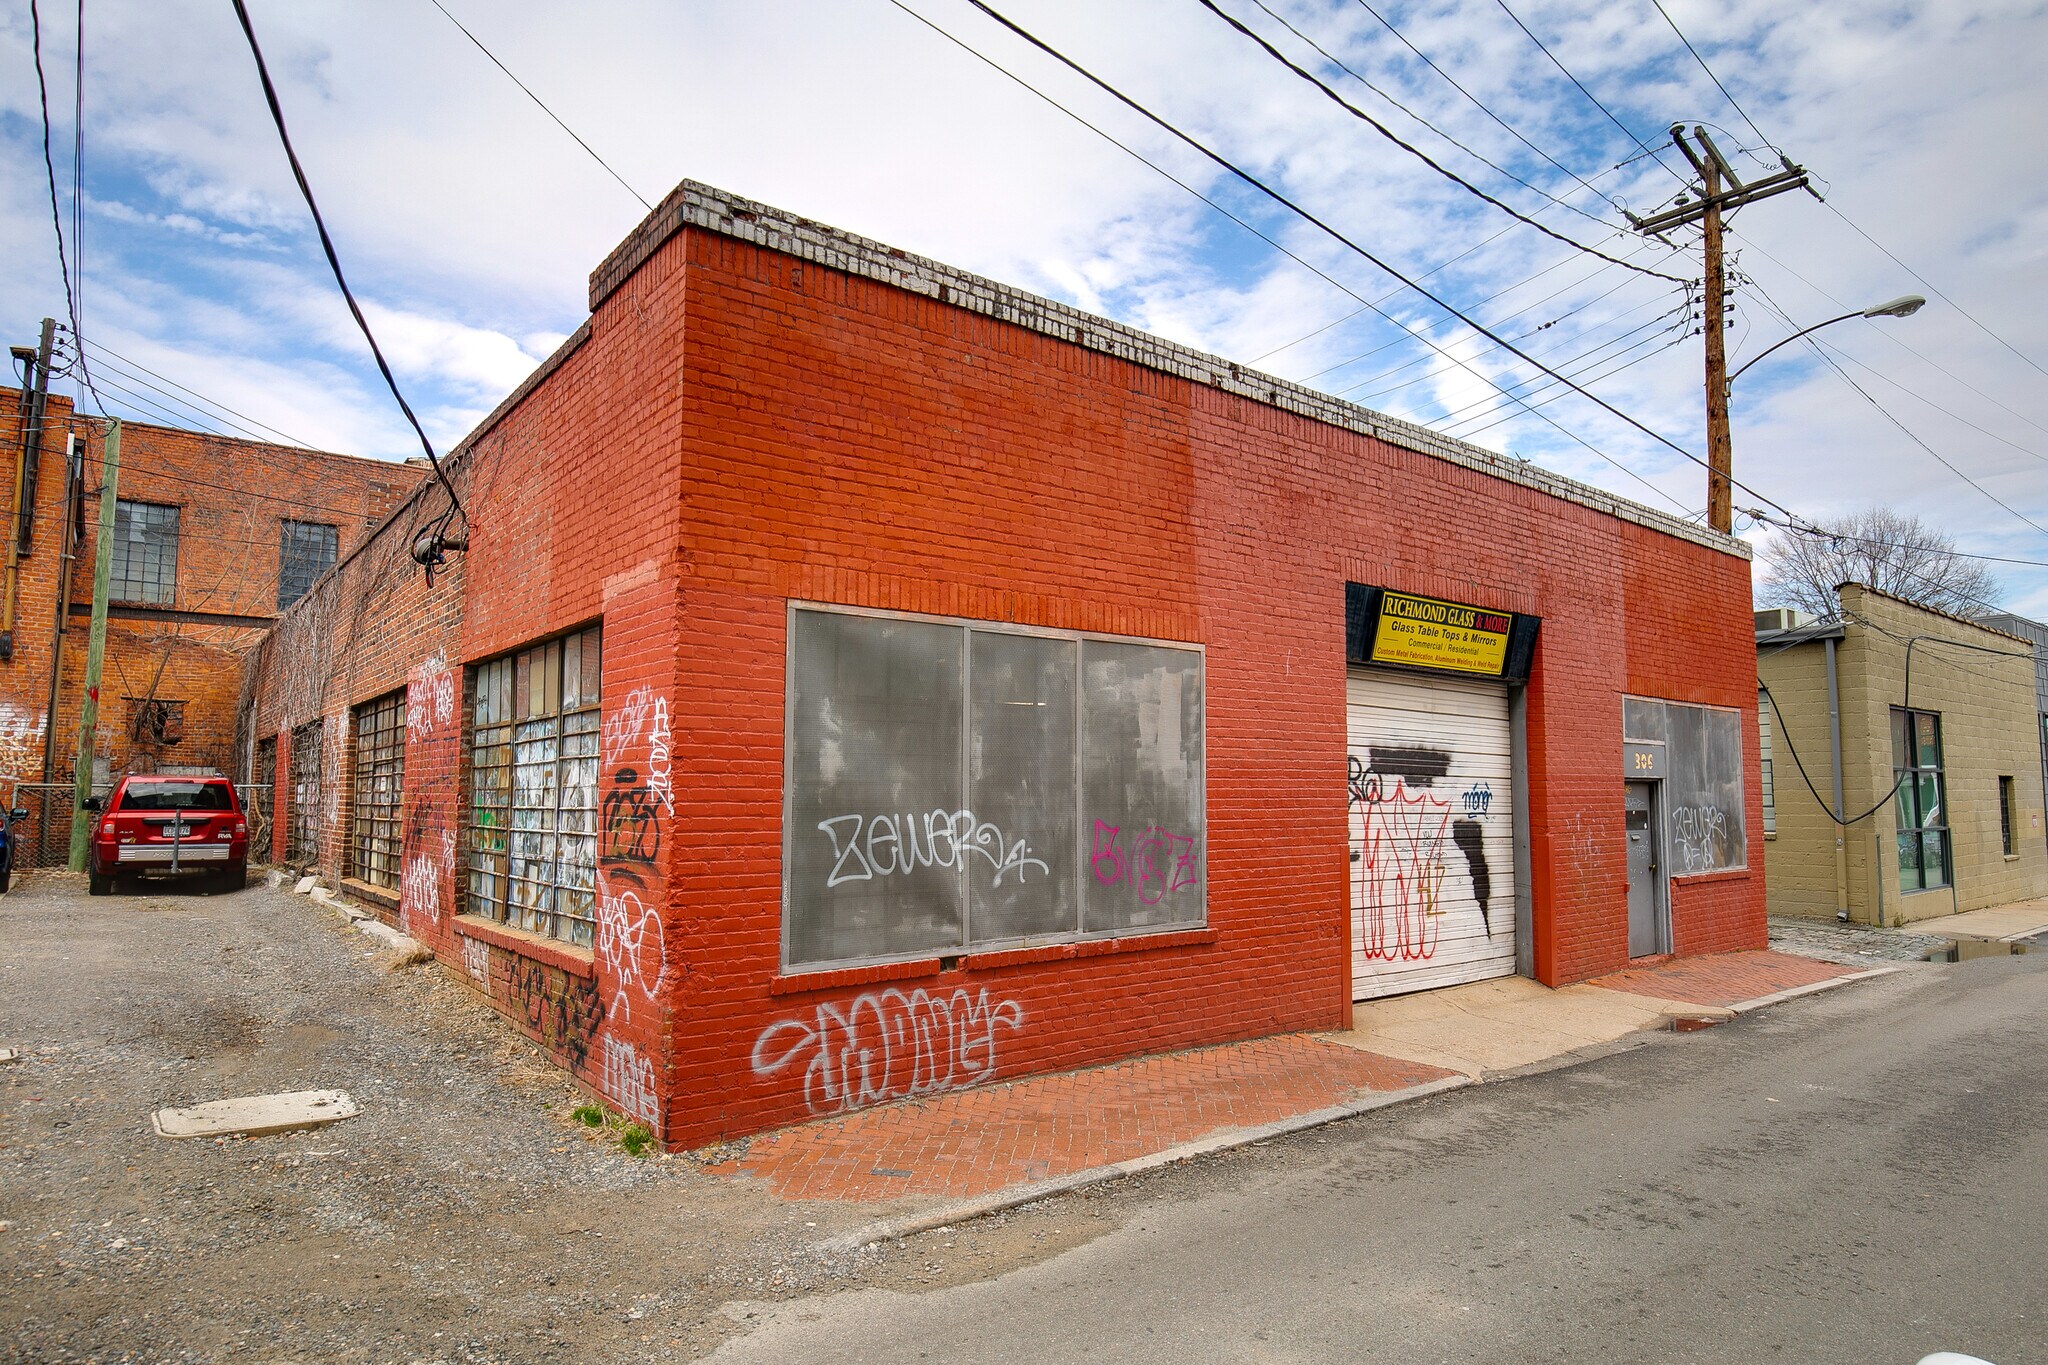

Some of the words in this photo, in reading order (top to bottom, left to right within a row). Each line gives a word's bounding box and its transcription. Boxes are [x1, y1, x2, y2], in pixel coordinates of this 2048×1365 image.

[1385, 597, 1447, 622] RICHMOND
[1447, 608, 1476, 628] GLASS
[1475, 614, 1484, 629] &
[1484, 614, 1508, 633] MORE
[1391, 620, 1415, 634] Glass
[1418, 624, 1439, 638] Table
[1441, 628, 1460, 642] Tops
[1462, 631, 1469, 642] &
[1470, 633, 1498, 647] Mirrors
[1376, 646, 1396, 656] Custom
[1396, 649, 1409, 657] Metal
[1435, 655, 1456, 664] Aluminum
[1456, 657, 1473, 668] Welding
[1487, 661, 1500, 670] Repair
[1408, 637, 1443, 651] Commercial
[1447, 643, 1480, 656] Residential
[1634, 752, 1654, 770] 306
